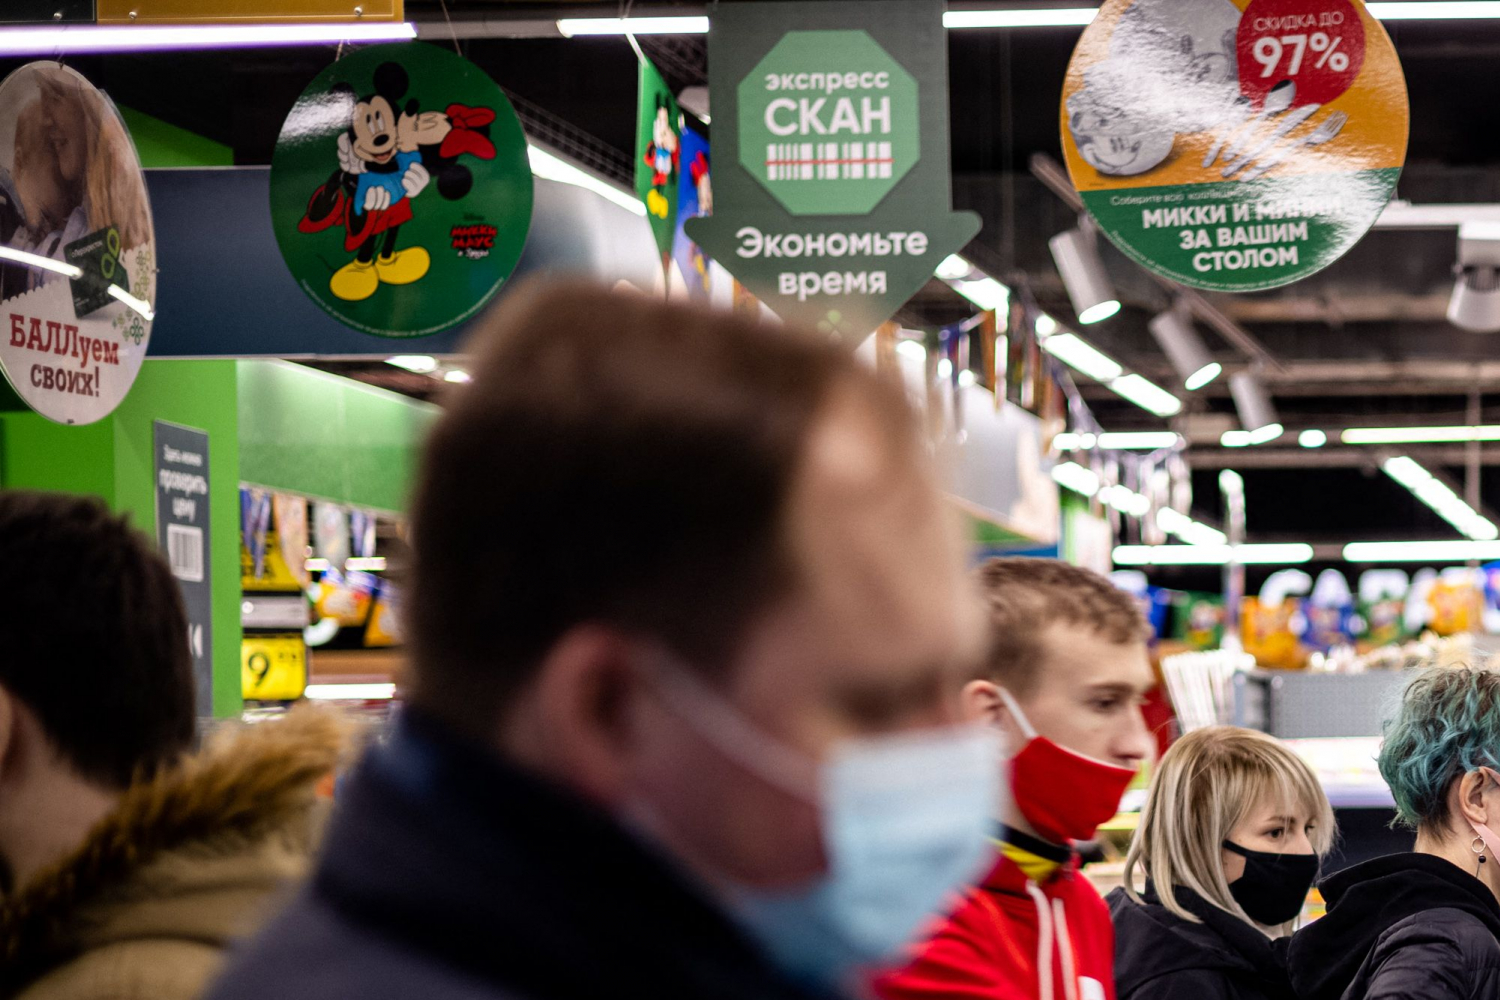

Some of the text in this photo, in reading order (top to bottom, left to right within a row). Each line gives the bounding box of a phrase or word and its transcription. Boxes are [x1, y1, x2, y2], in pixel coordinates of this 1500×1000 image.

[1253, 11, 1344, 31] СКИДКА ДО
[1253, 31, 1349, 78] 97%
[765, 71, 889, 94] экспресс
[764, 97, 891, 136] СКАН
[1142, 205, 1226, 229] МИККИ
[1233, 203, 1249, 223] И
[735, 227, 928, 258] Экономьте
[1180, 222, 1308, 250] ЗА ВАШИМ
[1193, 246, 1298, 272] СТОЛОМ
[778, 271, 887, 301] время
[9, 313, 119, 368] БАЛЛуем
